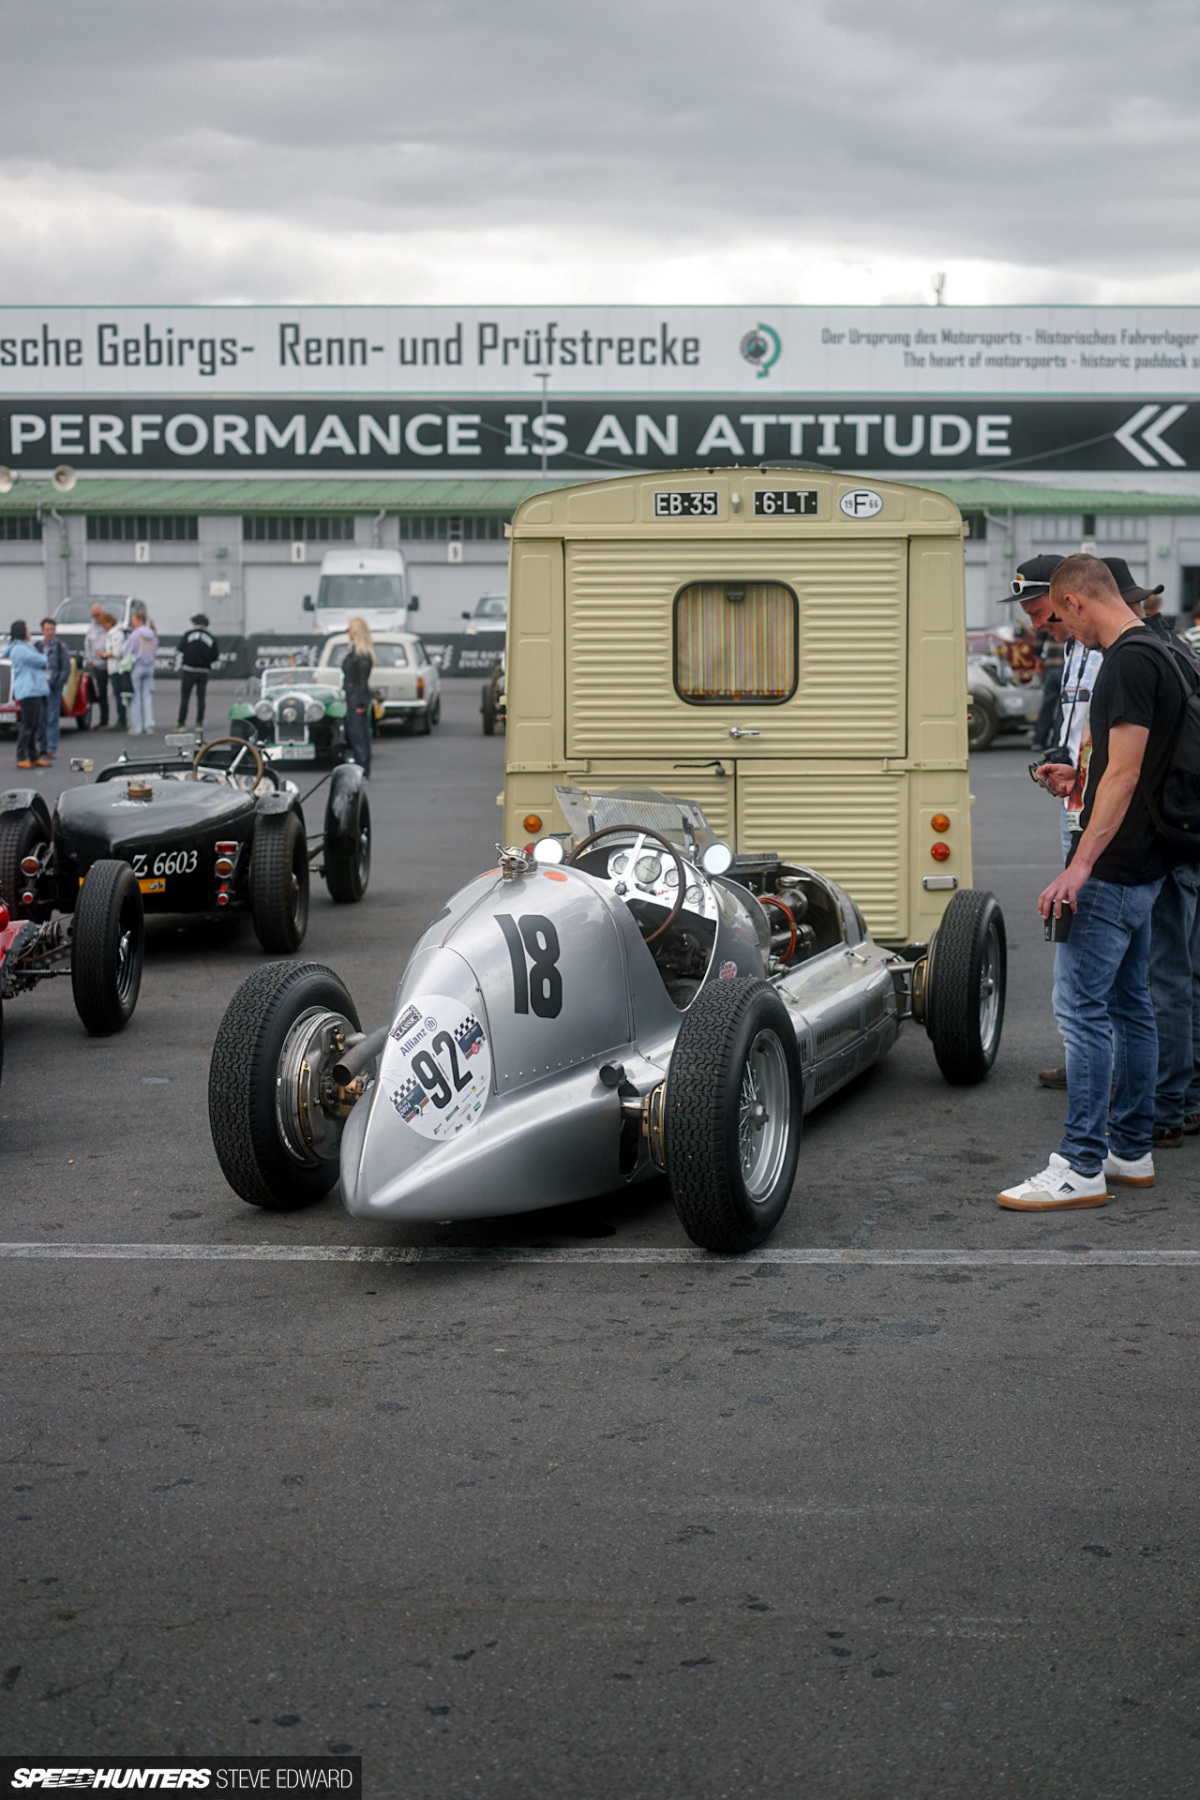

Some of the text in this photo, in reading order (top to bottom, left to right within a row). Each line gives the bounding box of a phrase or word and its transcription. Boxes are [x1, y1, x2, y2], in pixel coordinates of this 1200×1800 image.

[98, 323, 254, 376] Gebirgs-
[279, 323, 384, 366] Renn-
[400, 323, 462, 366] und
[478, 322, 700, 366] Prüfstrecke
[821, 328, 845, 345] Der
[849, 328, 911, 347] Ursprung
[914, 329, 937, 345] des
[941, 328, 1022, 347] Motorsports
[1035, 328, 1117, 346] Historisches
[1121, 328, 1199, 348] Fahrerlager
[903, 351, 926, 367] The
[929, 351, 965, 367] heart
[968, 351, 982, 367] of
[984, 353, 1066, 371] motorsports
[1080, 351, 1130, 368] historic
[1134, 352, 1187, 371] paddock
[10, 414, 1012, 456] PERFORMANCE IS AN ATTITUDE
[844, 493, 879, 514] 19 F 66
[153, 850, 198, 876] 6603
[493, 913, 563, 1019] 18
[400, 1028, 428, 1057] Allianz
[411, 1030, 474, 1109] 92
